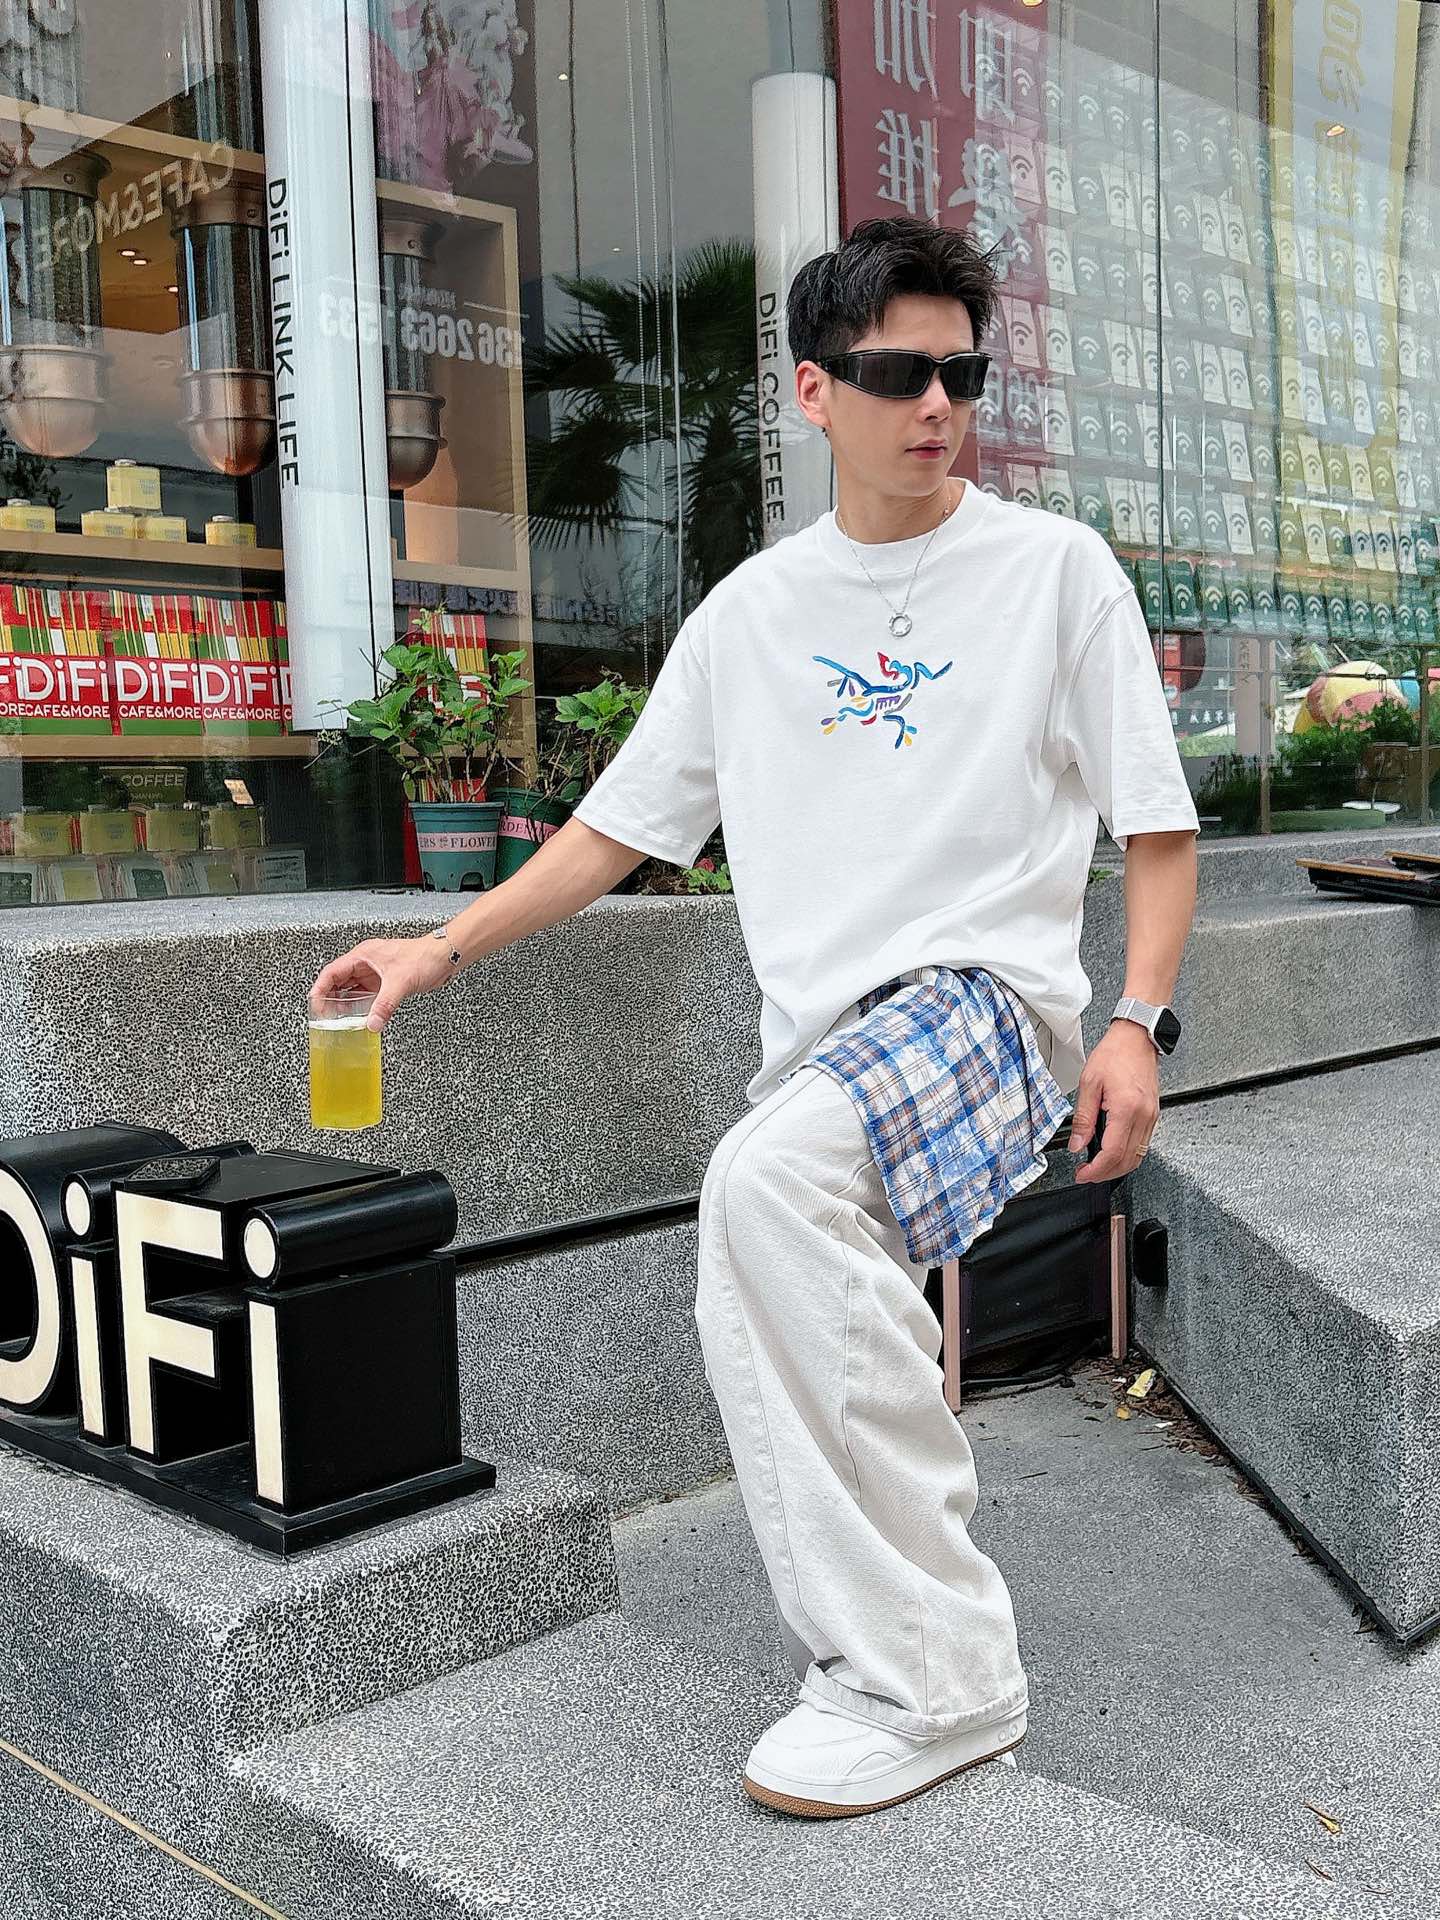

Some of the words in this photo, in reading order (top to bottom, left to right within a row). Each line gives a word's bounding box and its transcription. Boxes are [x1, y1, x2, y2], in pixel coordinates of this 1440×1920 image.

[268, 178, 290, 260] DiFi
[272, 273, 295, 380] LINK
[760, 292, 778, 361] DiFi
[277, 393, 300, 489] LIFE
[762, 371, 785, 524] COFFEE
[21, 657, 110, 702] DiFi
[115, 660, 200, 704] DiFi
[200, 663, 280, 706] DiFi
[25, 703, 110, 719] CAFE&MORE
[119, 704, 201, 720] CAFE&MORE
[203, 706, 281, 720] CAFE&MORE
